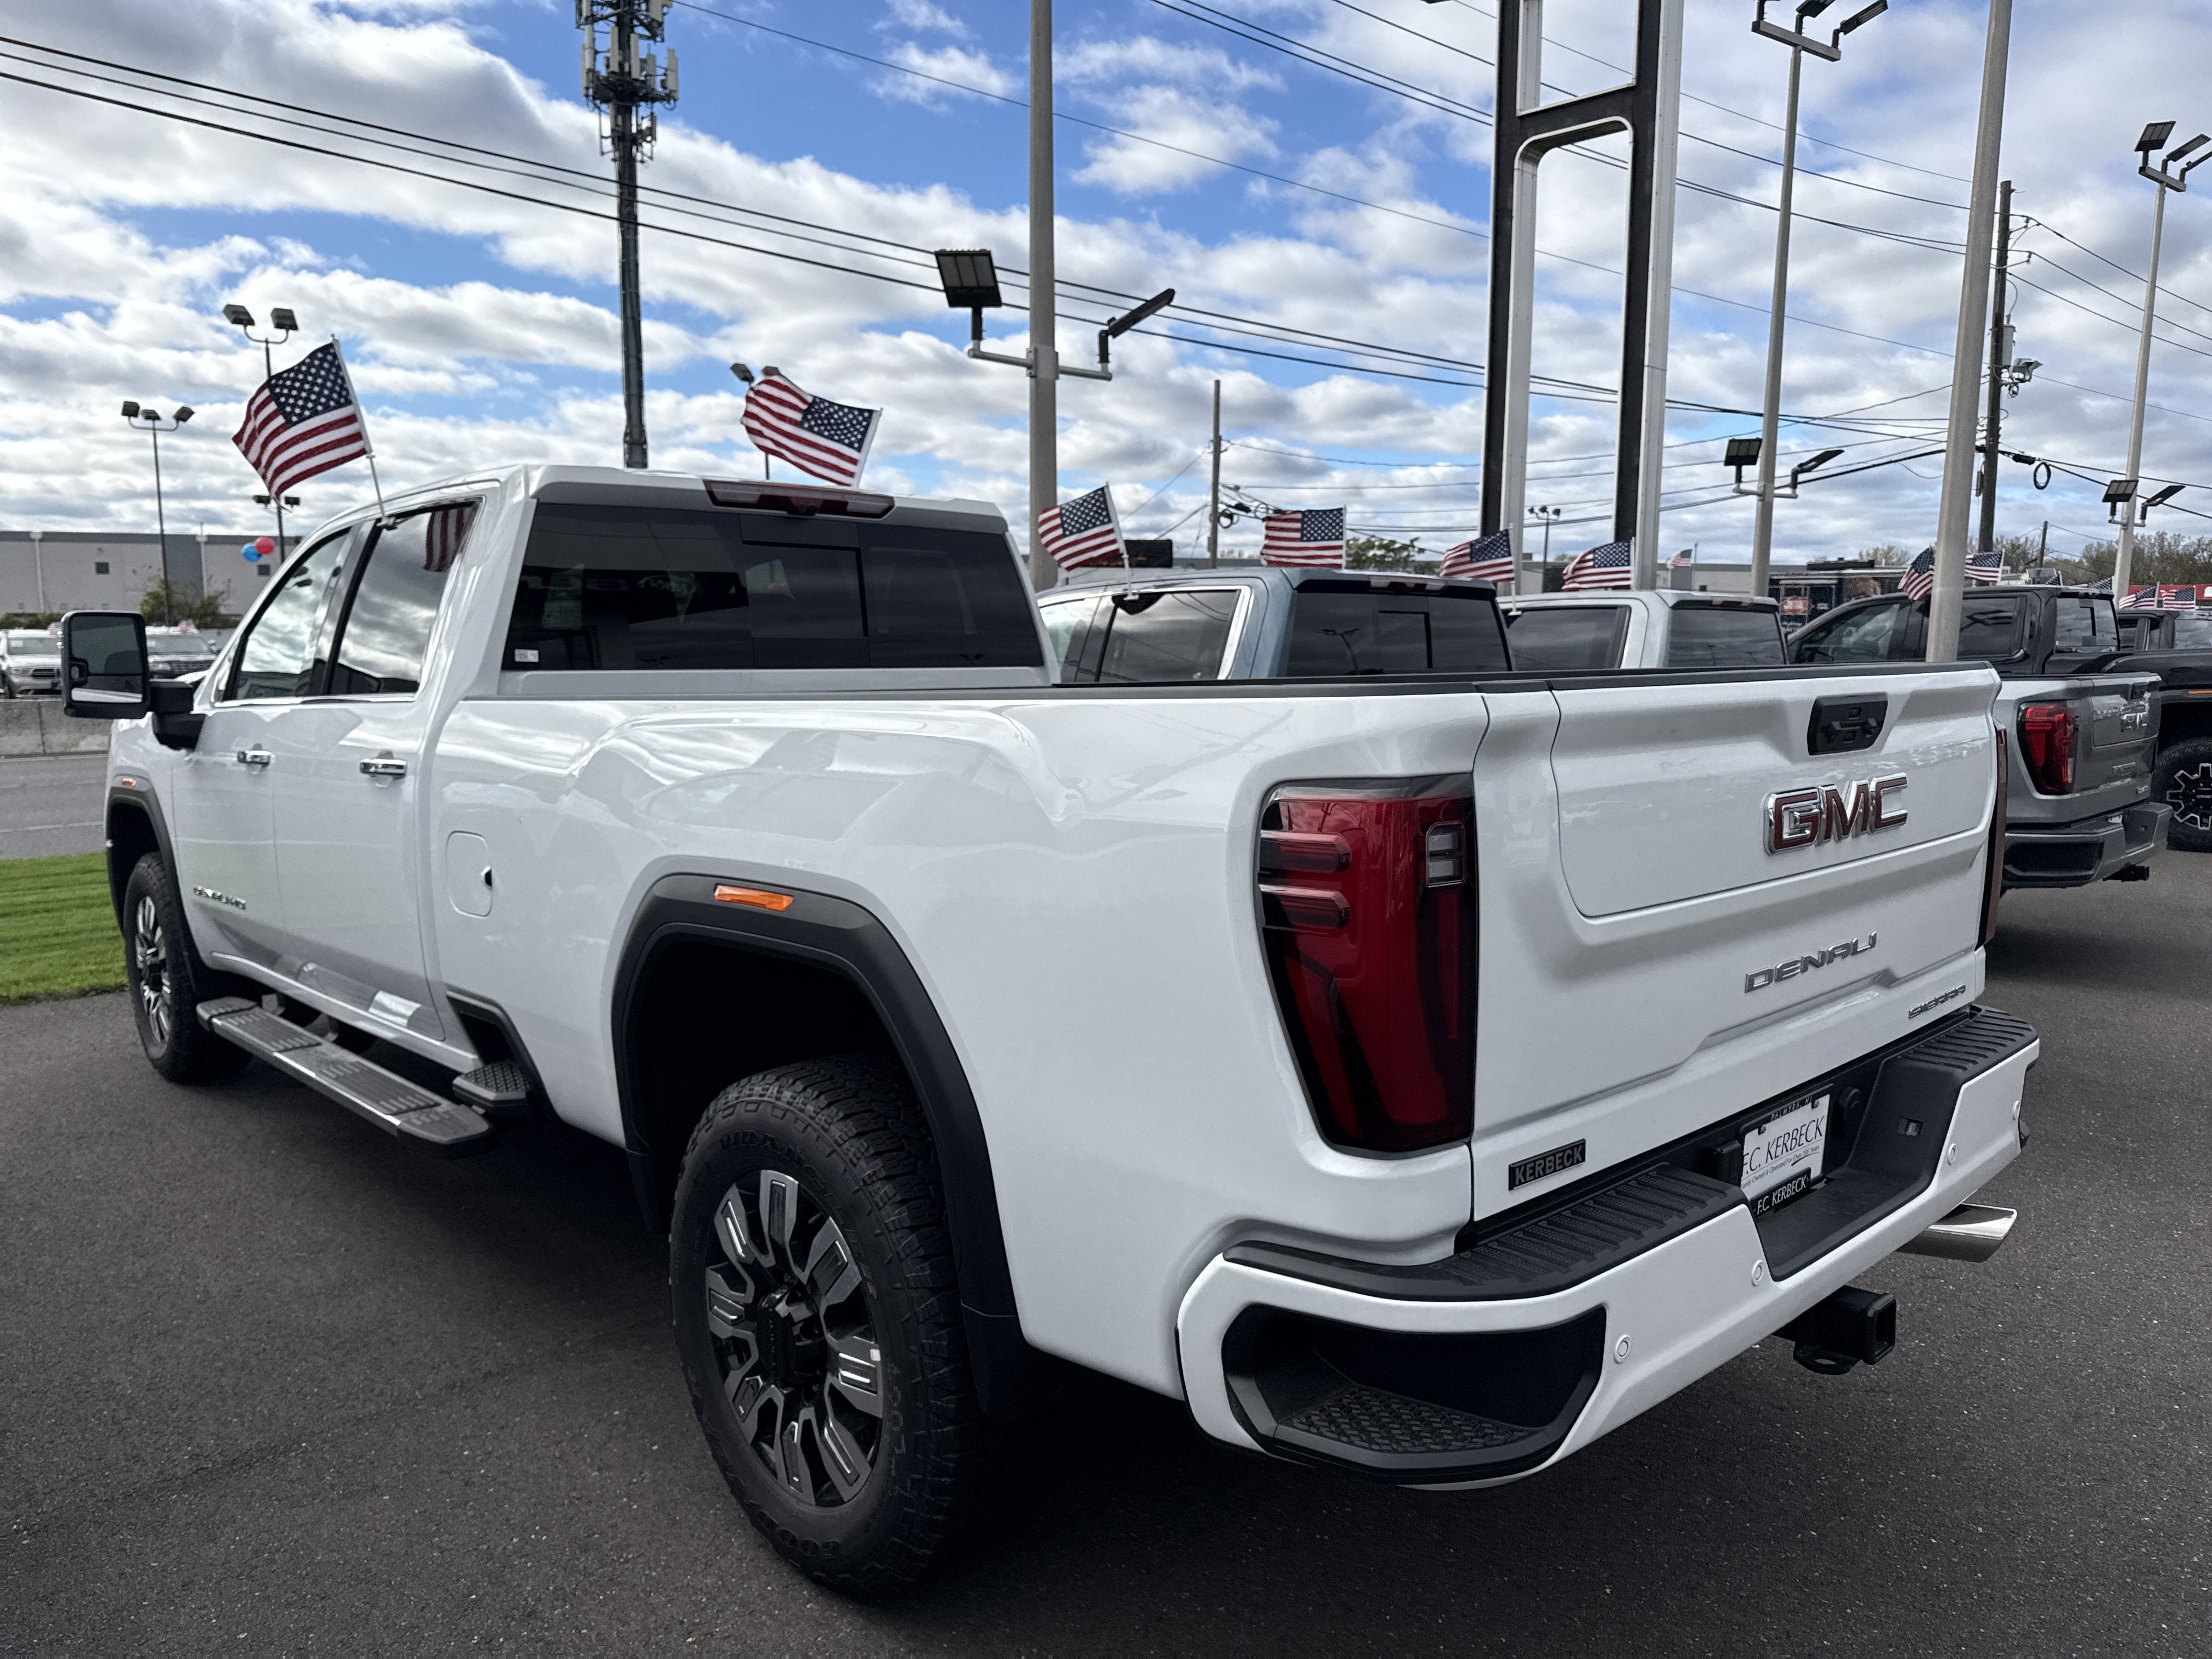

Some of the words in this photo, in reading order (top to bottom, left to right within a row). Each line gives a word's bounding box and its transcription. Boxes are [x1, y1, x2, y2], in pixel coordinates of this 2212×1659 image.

[1764, 772, 1908, 855] GMC
[1745, 932, 1877, 994] DENALI
[1909, 984, 1966, 1019] SIERRA
[1765, 1115, 1824, 1163] KERBECK
[1515, 1145, 1582, 1185] KERBECK
[1757, 1195, 1770, 1215] F.C.
[1771, 1175, 1807, 1206] KERBECK
